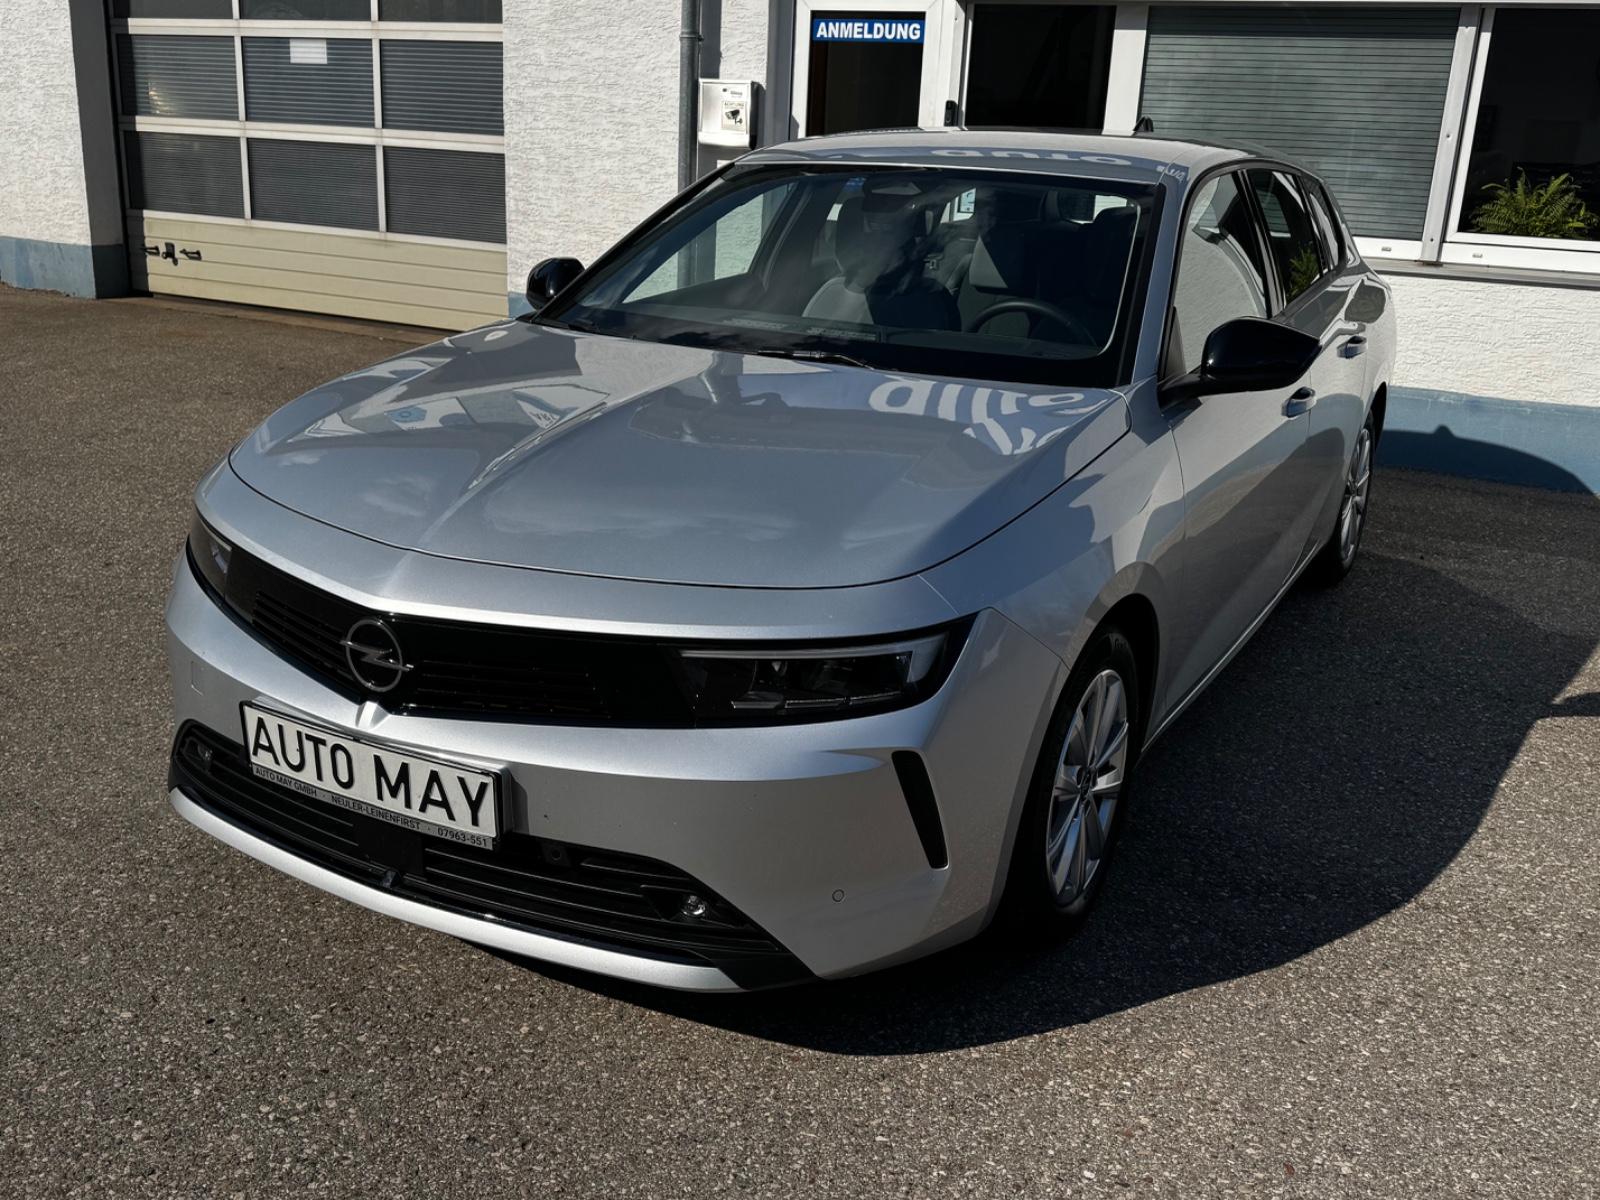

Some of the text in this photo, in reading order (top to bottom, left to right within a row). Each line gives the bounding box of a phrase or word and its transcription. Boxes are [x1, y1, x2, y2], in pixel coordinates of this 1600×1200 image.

[816, 20, 921, 41] ANMELDUNG
[251, 716, 490, 828] AUTO MAY
[255, 766, 488, 848] AUTO MAY GMBH NEULER-LEINENFIRST 07963-551
